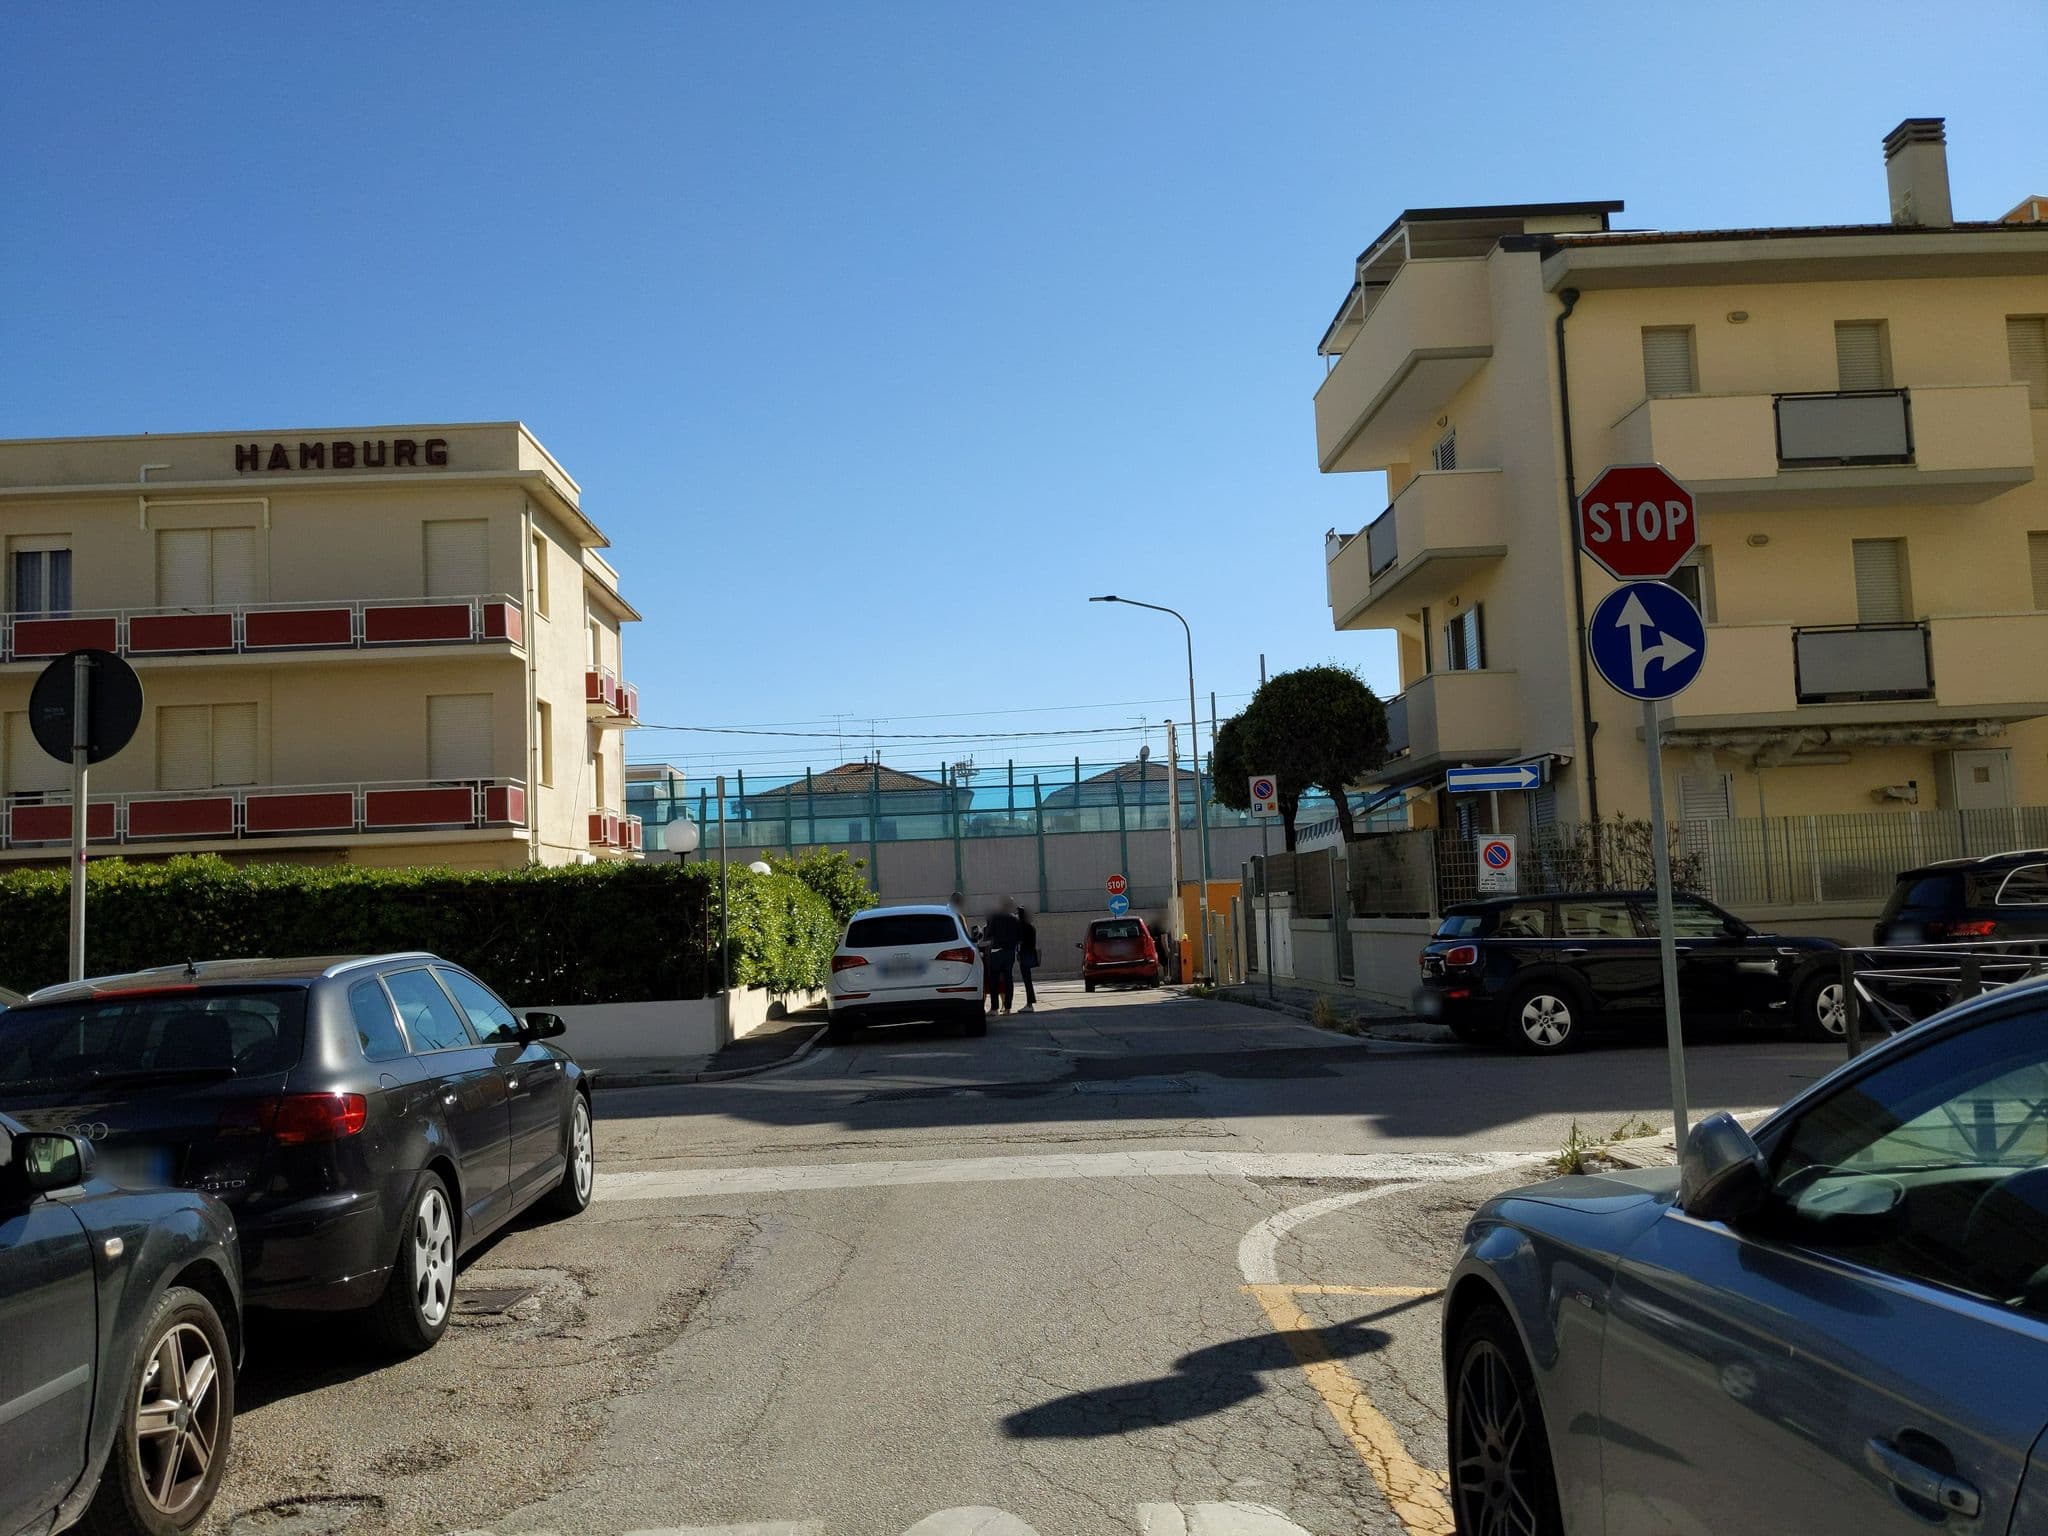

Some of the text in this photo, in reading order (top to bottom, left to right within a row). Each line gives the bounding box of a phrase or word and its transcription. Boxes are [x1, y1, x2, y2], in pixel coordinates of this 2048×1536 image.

[235, 438, 448, 471] HAMBURG
[1588, 500, 1688, 543] STOP
[1107, 880, 1125, 890] STOP
